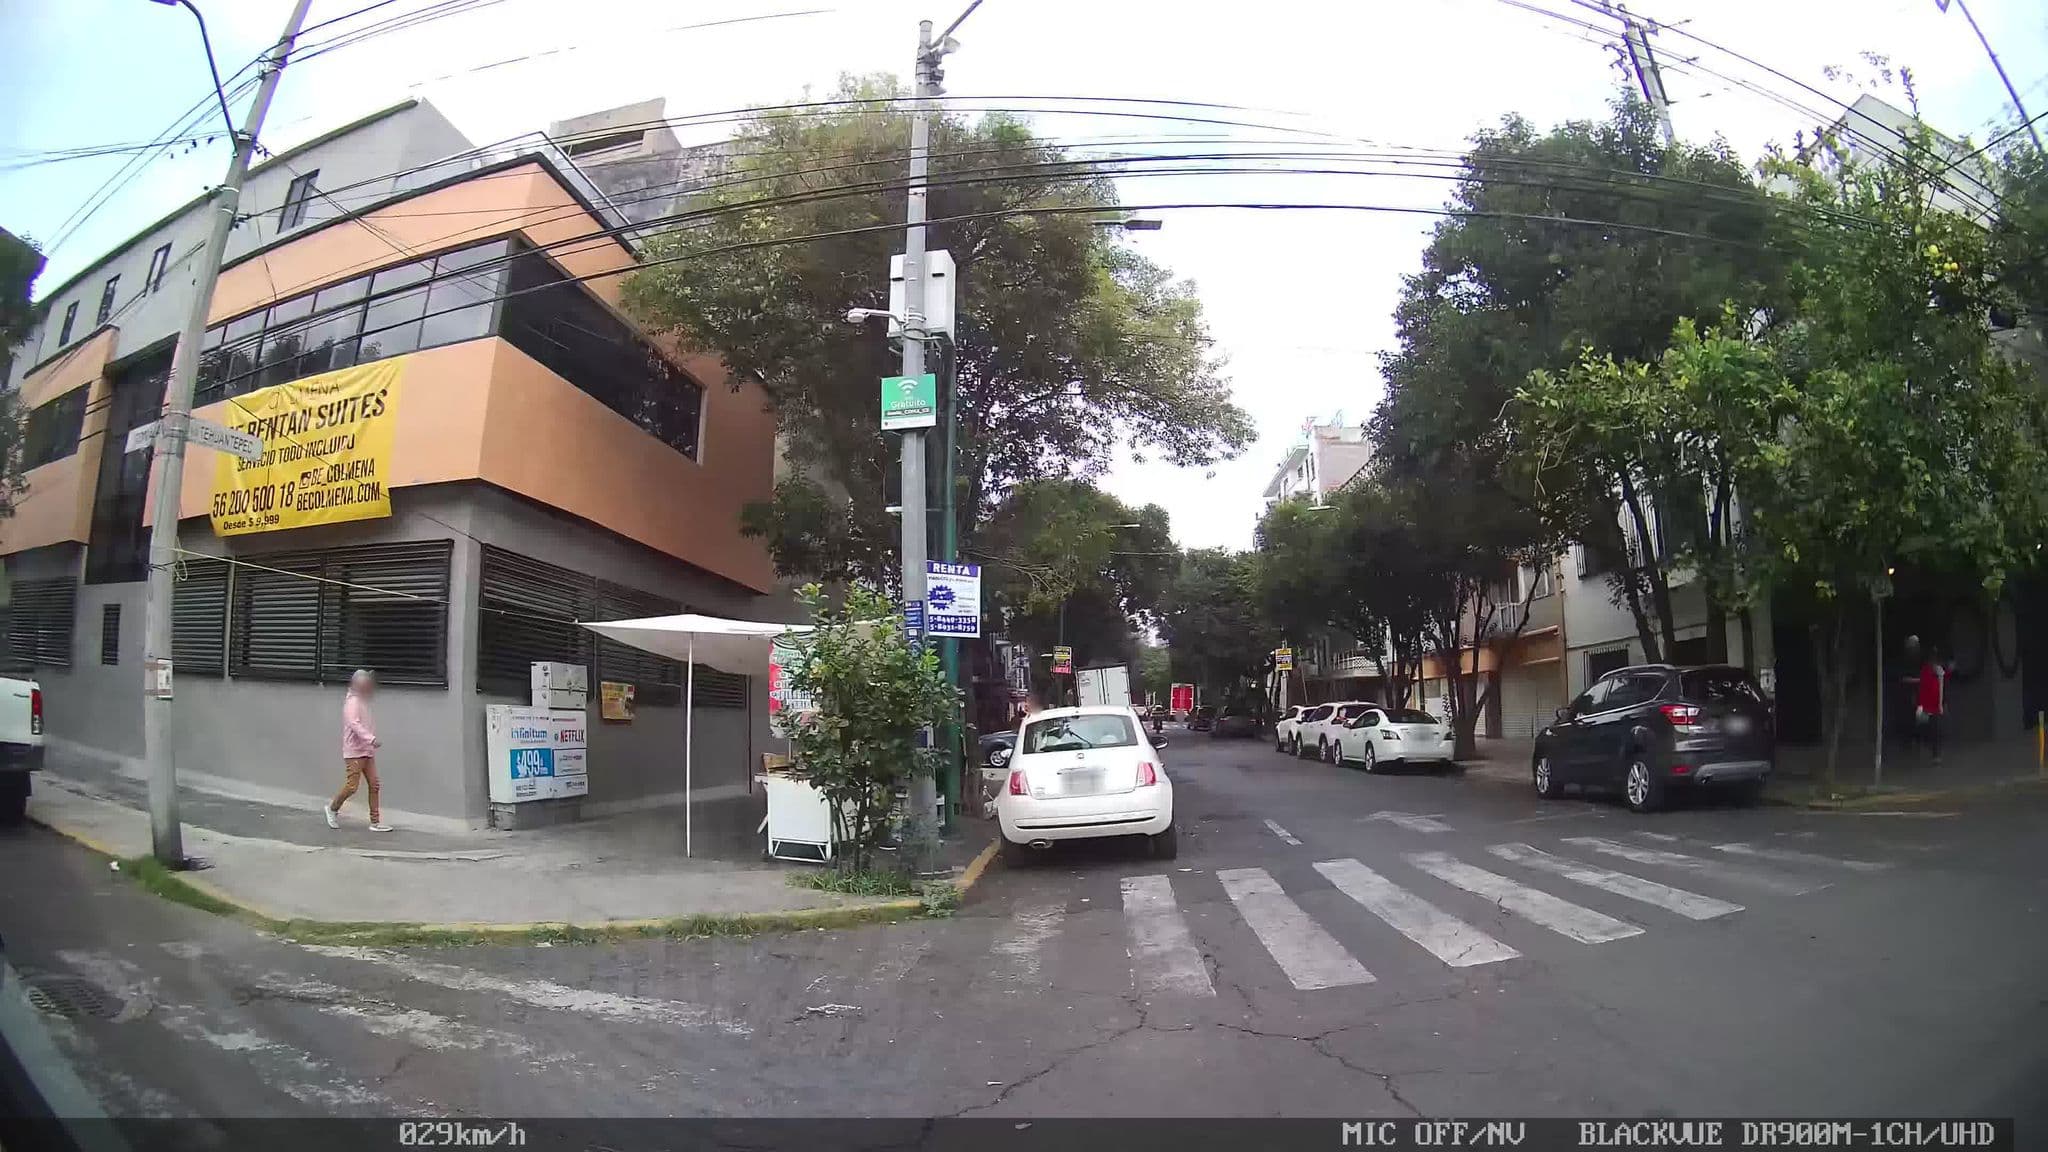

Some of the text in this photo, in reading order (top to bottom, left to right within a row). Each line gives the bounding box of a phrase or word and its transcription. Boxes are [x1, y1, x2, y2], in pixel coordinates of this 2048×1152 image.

[890, 399, 926, 409] Gratuito
[247, 388, 388, 442] RENTAN SUITES
[200, 426, 254, 454] TEHUANTEPEC
[212, 481, 296, 518] 56 200 500 18
[223, 518, 247, 531] Desde
[932, 562, 971, 576] RENTA
[560, 729, 585, 744] NETFLIX
